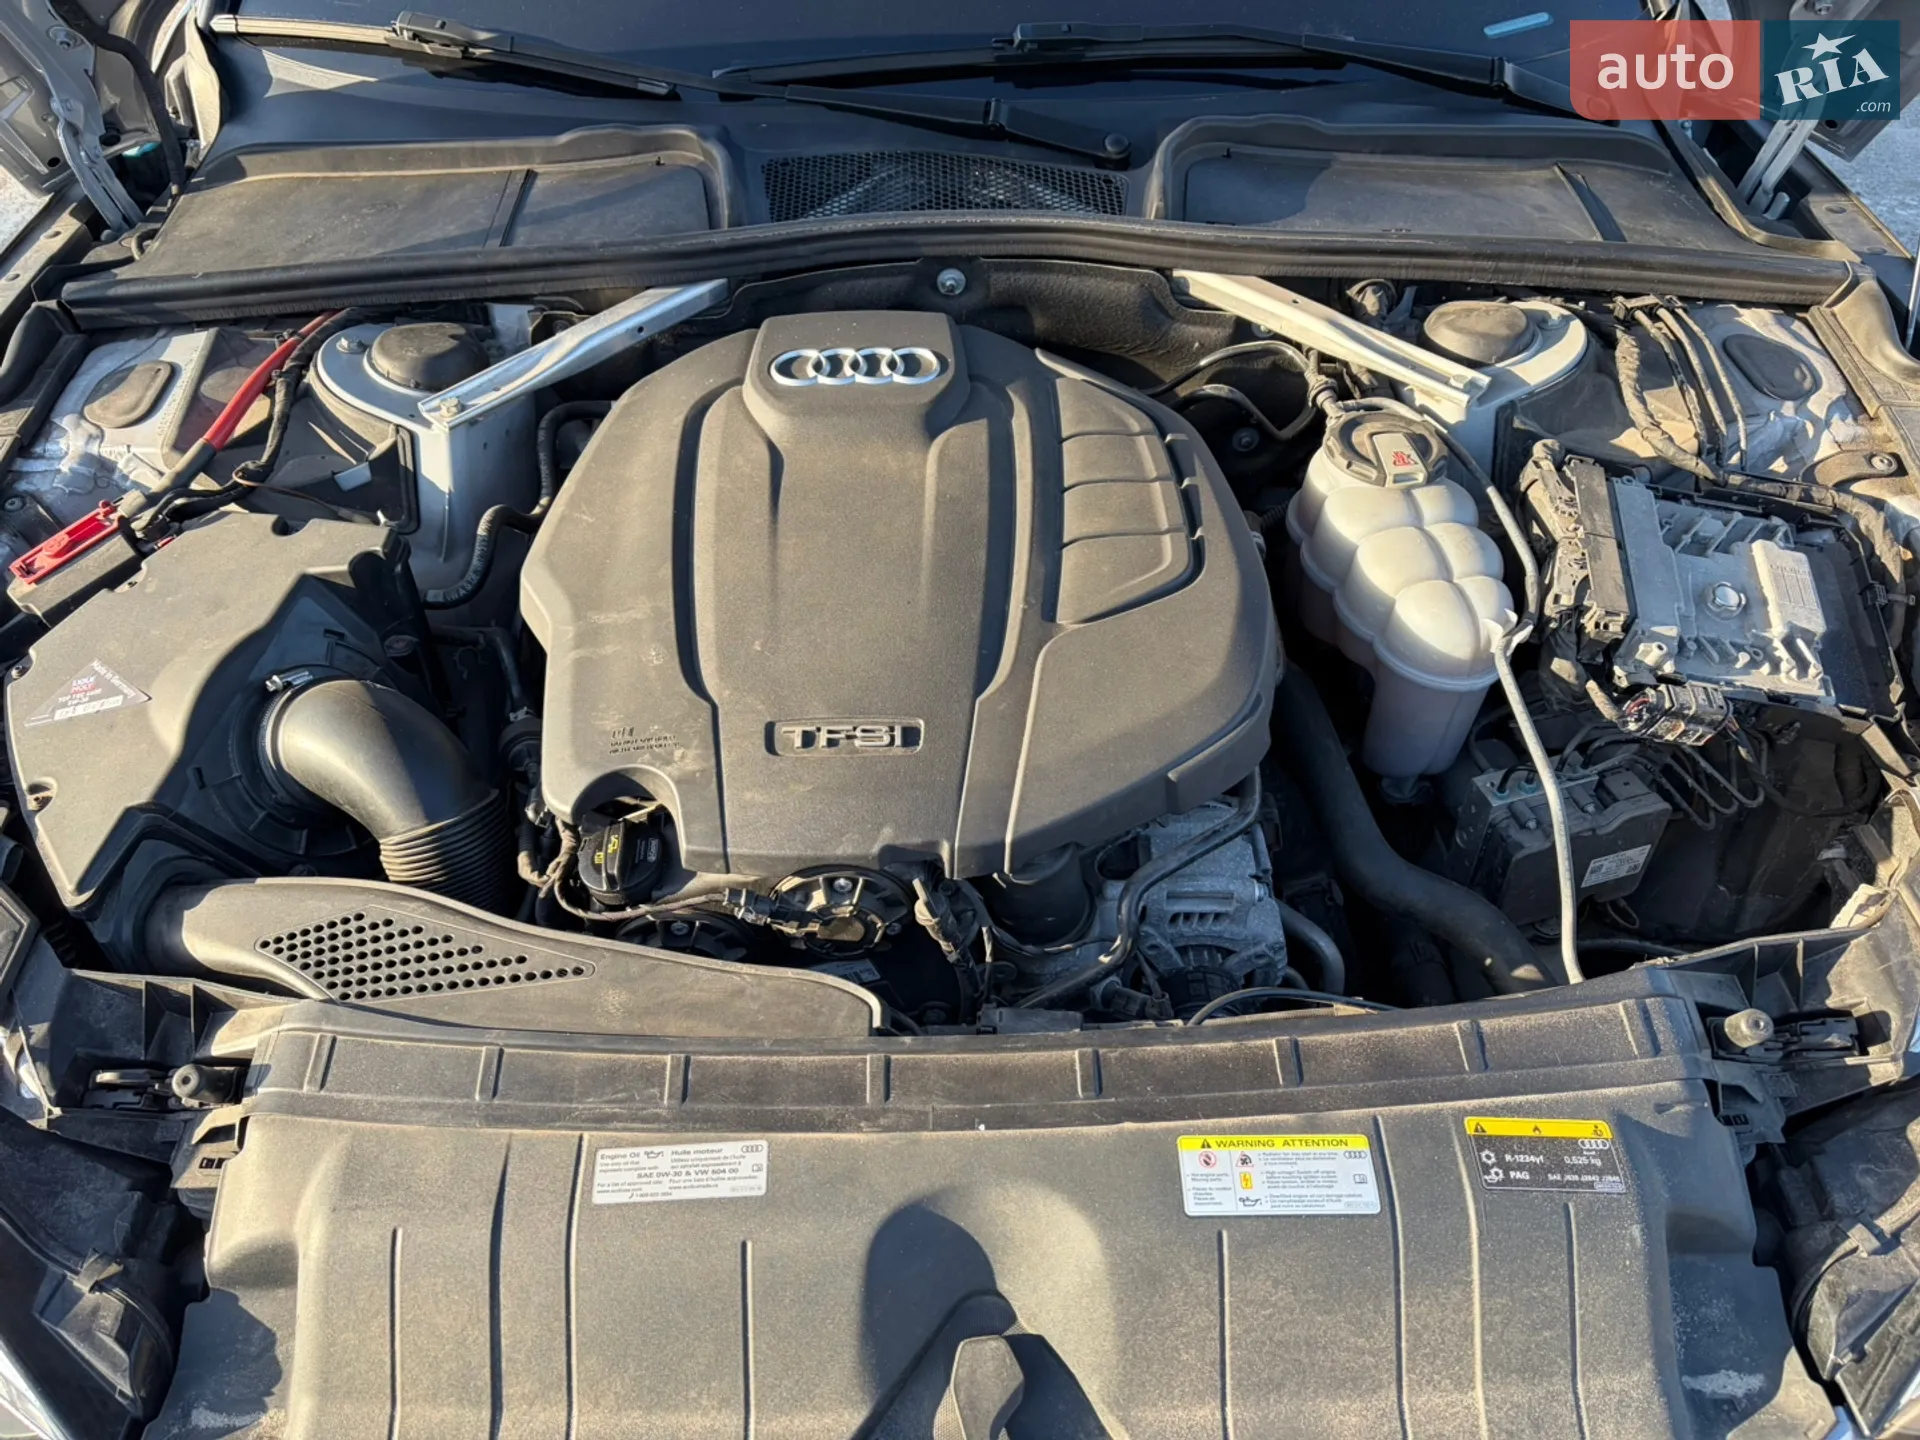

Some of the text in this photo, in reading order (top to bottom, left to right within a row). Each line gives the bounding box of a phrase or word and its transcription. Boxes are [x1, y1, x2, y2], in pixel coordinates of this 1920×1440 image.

[781, 725, 903, 749] TFSI
[1215, 1138, 1349, 1148] WARNING ATTENTION
[600, 1151, 641, 1161] Engine Oil
[671, 1147, 723, 1156] Huile moteur
[1563, 1156, 1587, 1165] 0,525
[1589, 1156, 1602, 1167] kg
[1509, 1171, 1530, 1180] PAG
[1547, 1173, 1562, 1181] SAE
